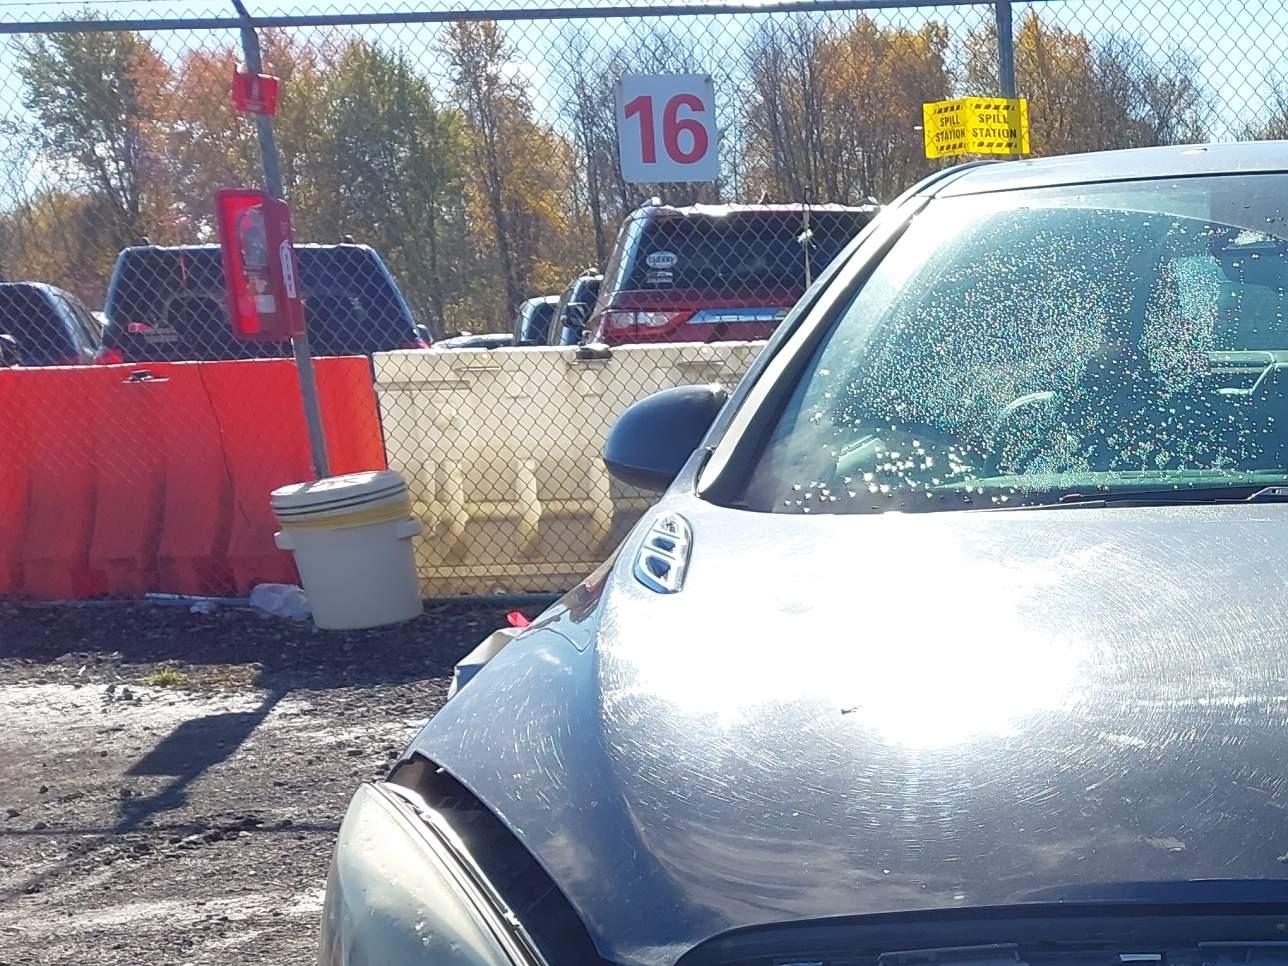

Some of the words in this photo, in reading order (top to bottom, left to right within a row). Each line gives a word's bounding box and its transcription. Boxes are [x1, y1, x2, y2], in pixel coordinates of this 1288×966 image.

[939, 115, 961, 127] SPILL
[978, 113, 1009, 124] SPILL
[623, 93, 709, 165] 16
[935, 128, 966, 142] STATION
[972, 127, 1017, 138] STATION
